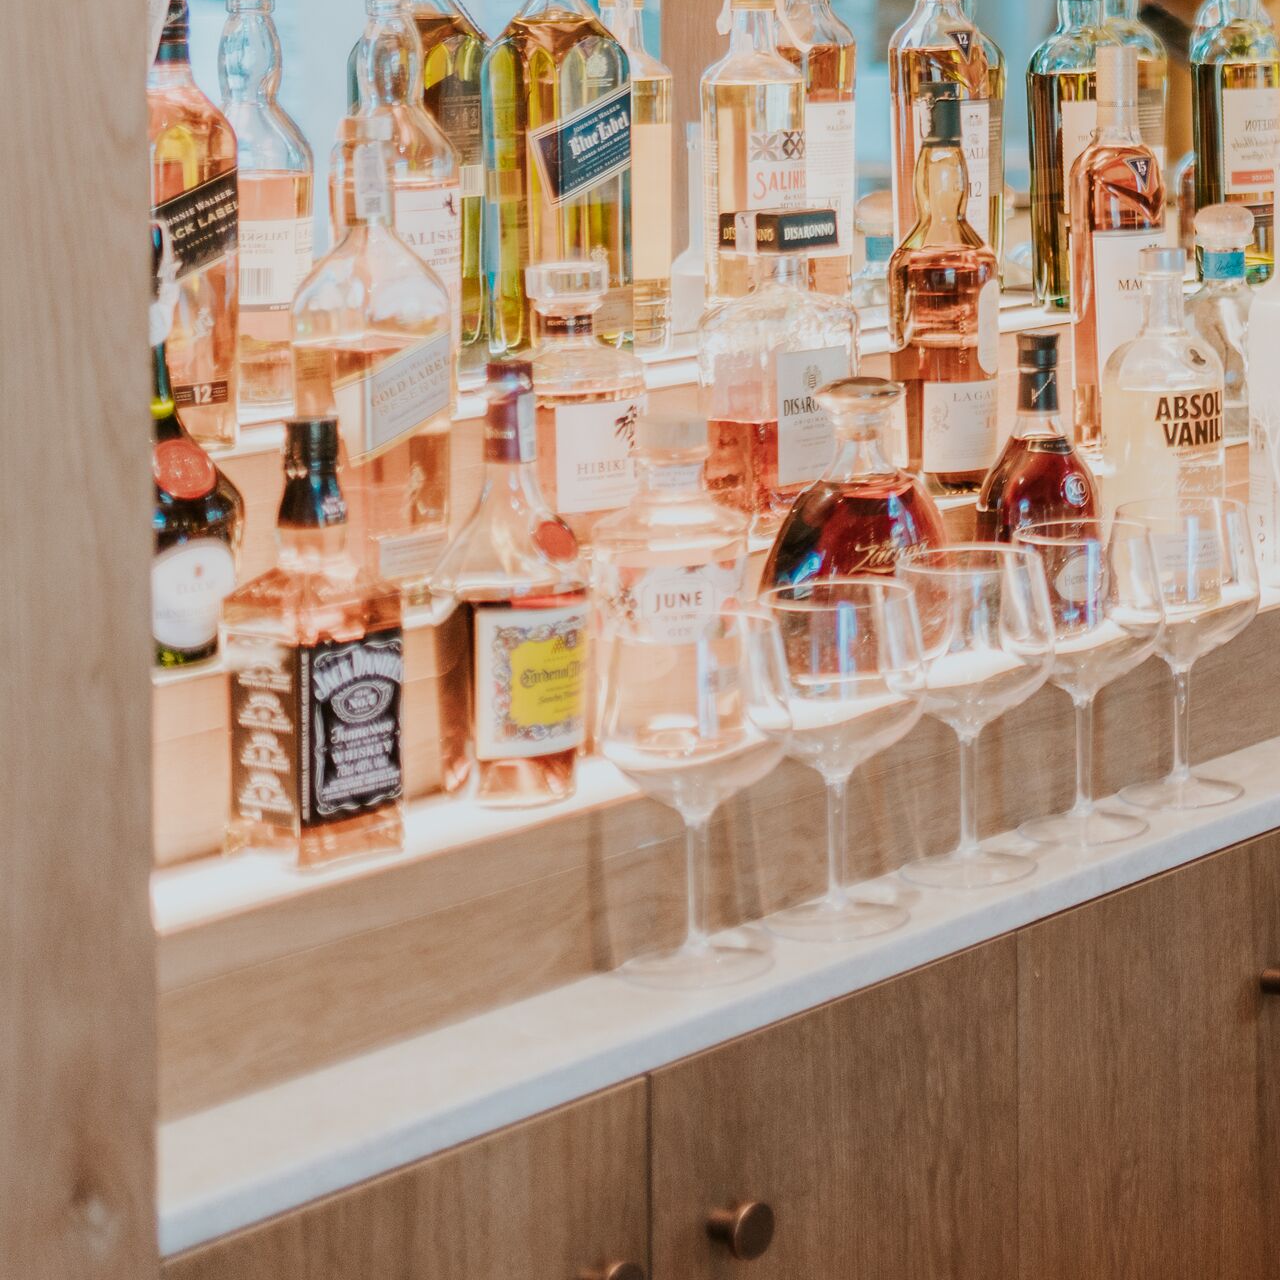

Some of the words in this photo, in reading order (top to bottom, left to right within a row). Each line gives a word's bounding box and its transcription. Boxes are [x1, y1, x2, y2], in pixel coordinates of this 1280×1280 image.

[957, 33, 969, 45] 12
[568, 131, 599, 159] Blue
[596, 111, 630, 143] Label
[1137, 161, 1147, 174] 15
[197, 200, 238, 228] LABEL
[784, 222, 835, 241] DISARONNO
[193, 384, 213, 405] 12
[1155, 390, 1222, 421] ABSOL
[1163, 417, 1222, 448] VANIL
[576, 460, 626, 476] HIBIKI
[653, 591, 704, 614] JUNE
